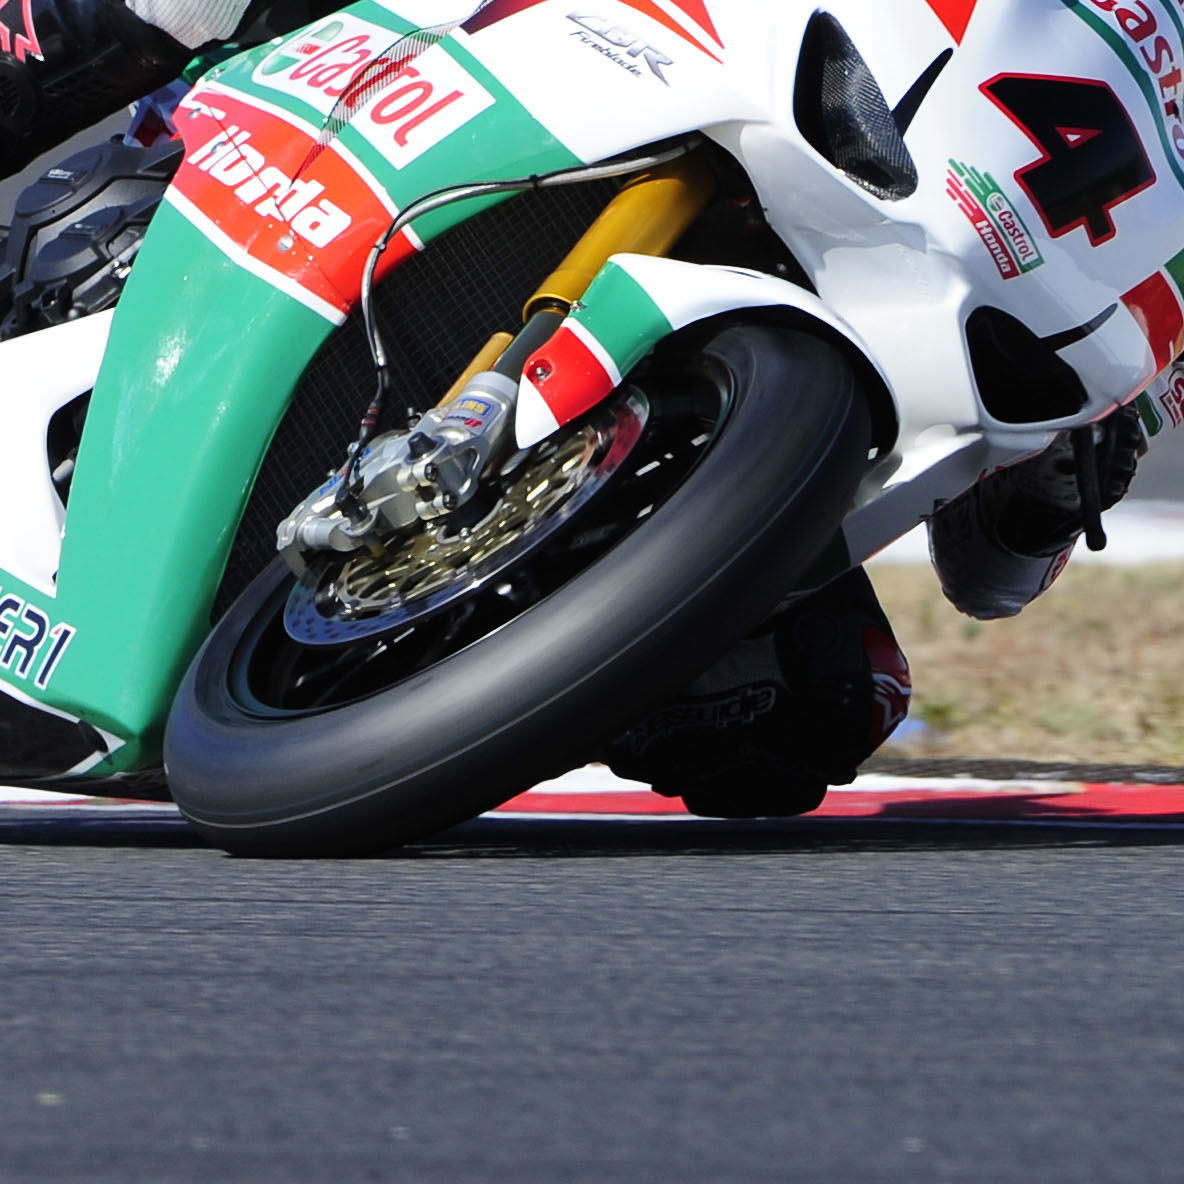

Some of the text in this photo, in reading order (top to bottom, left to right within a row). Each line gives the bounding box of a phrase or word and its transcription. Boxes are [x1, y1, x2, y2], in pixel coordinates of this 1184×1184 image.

[289, 34, 465, 147] Castrol
[979, 72, 1156, 247] 4
[998, 210, 1034, 262] Castrol
